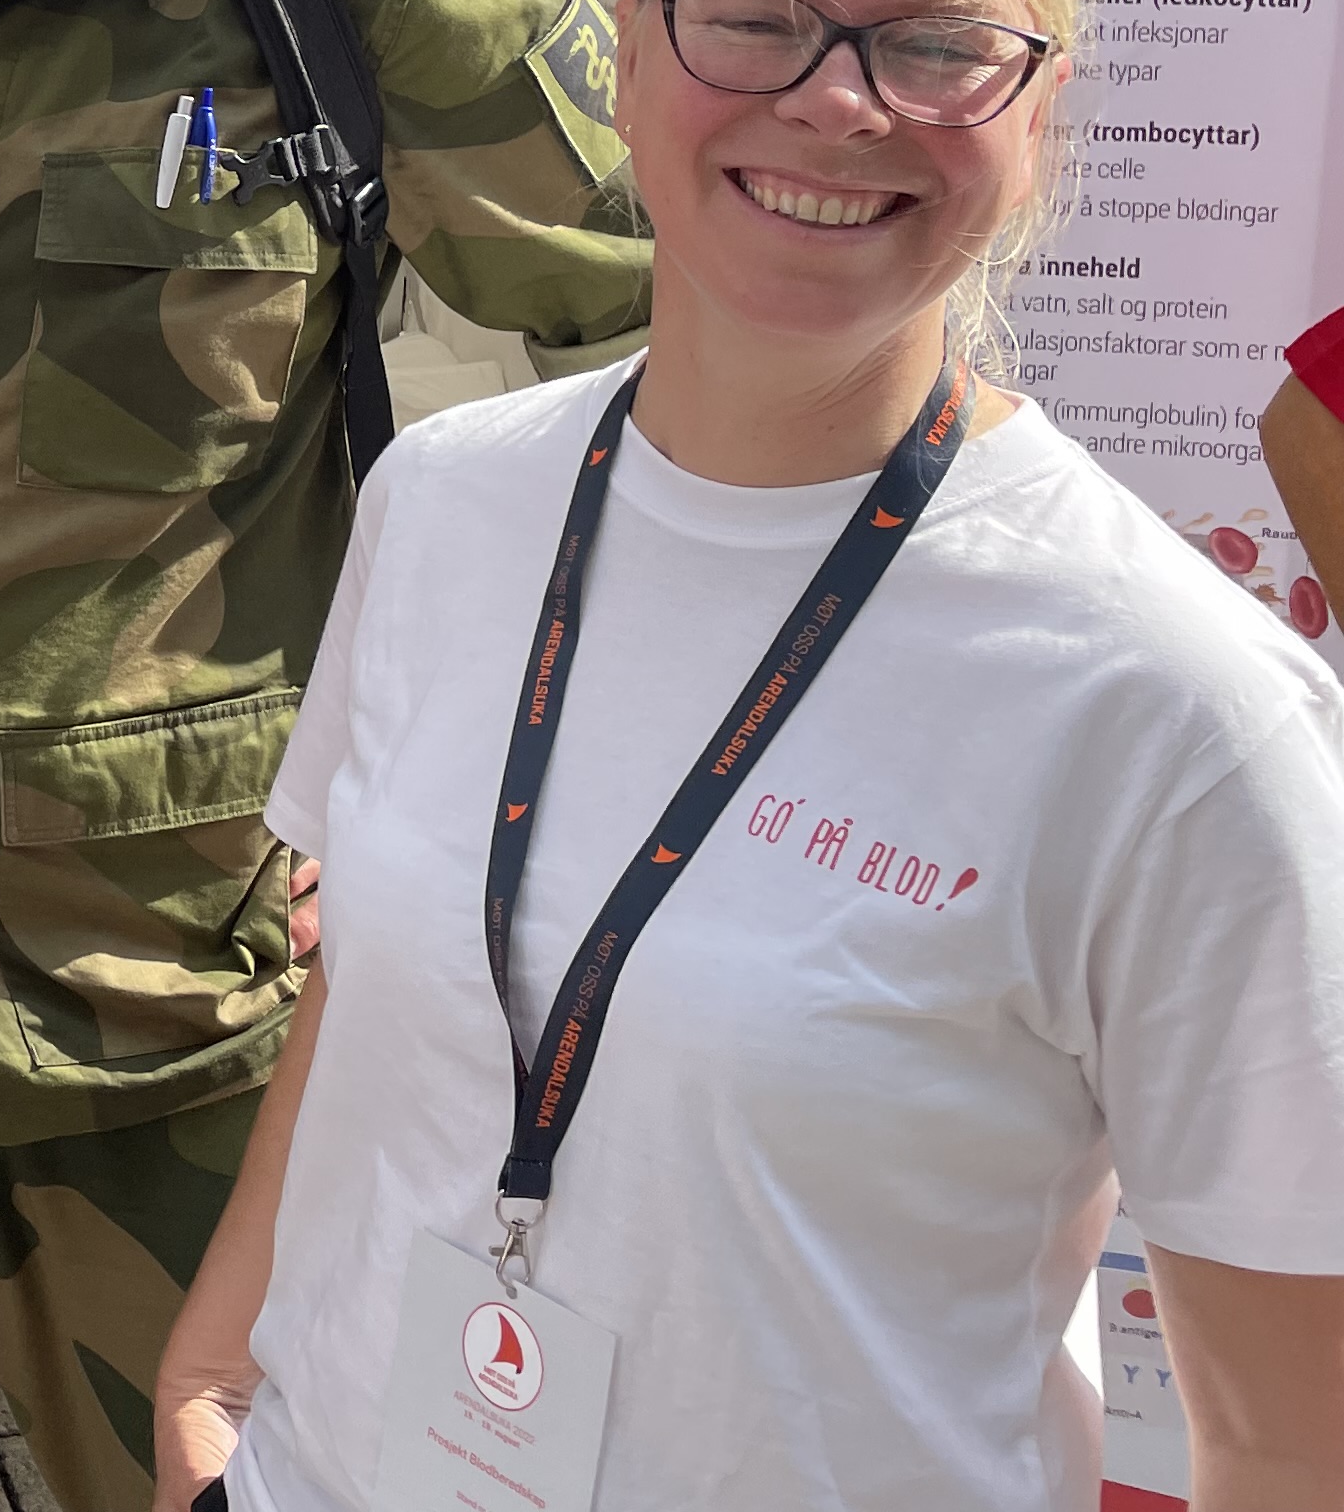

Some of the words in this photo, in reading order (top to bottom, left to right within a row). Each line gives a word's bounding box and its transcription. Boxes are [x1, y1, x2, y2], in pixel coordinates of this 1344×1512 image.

[1112, 20, 1229, 48] infeksjonar
[1109, 61, 1162, 86] typar
[1083, 120, 1260, 151] (trombocyttar)
[1097, 159, 1146, 180] celle
[1080, 194, 1092, 217] å
[1098, 199, 1171, 224] stoppe
[1177, 198, 1280, 227] blødingar
[1040, 254, 1141, 279] inneheld
[1021, 295, 1071, 317] vatn,
[1077, 293, 1114, 316] salt
[1120, 299, 1146, 322] og
[1153, 296, 1228, 322] protein
[1192, 342, 1239, 361] som
[1246, 343, 1268, 362] er
[1053, 397, 1227, 433] (immunglobulin)
[1087, 432, 1146, 455] andre
[792, 625, 821, 656] OSS
[528, 619, 565, 726] ARENDALSUKA
[711, 671, 789, 777] ARENDALSUKA
[804, 818, 854, 870] PÅ
[857, 841, 979, 912] BLOD!
[578, 964, 602, 1000] OSS
[534, 1017, 582, 1128] ARENDALSUKA
